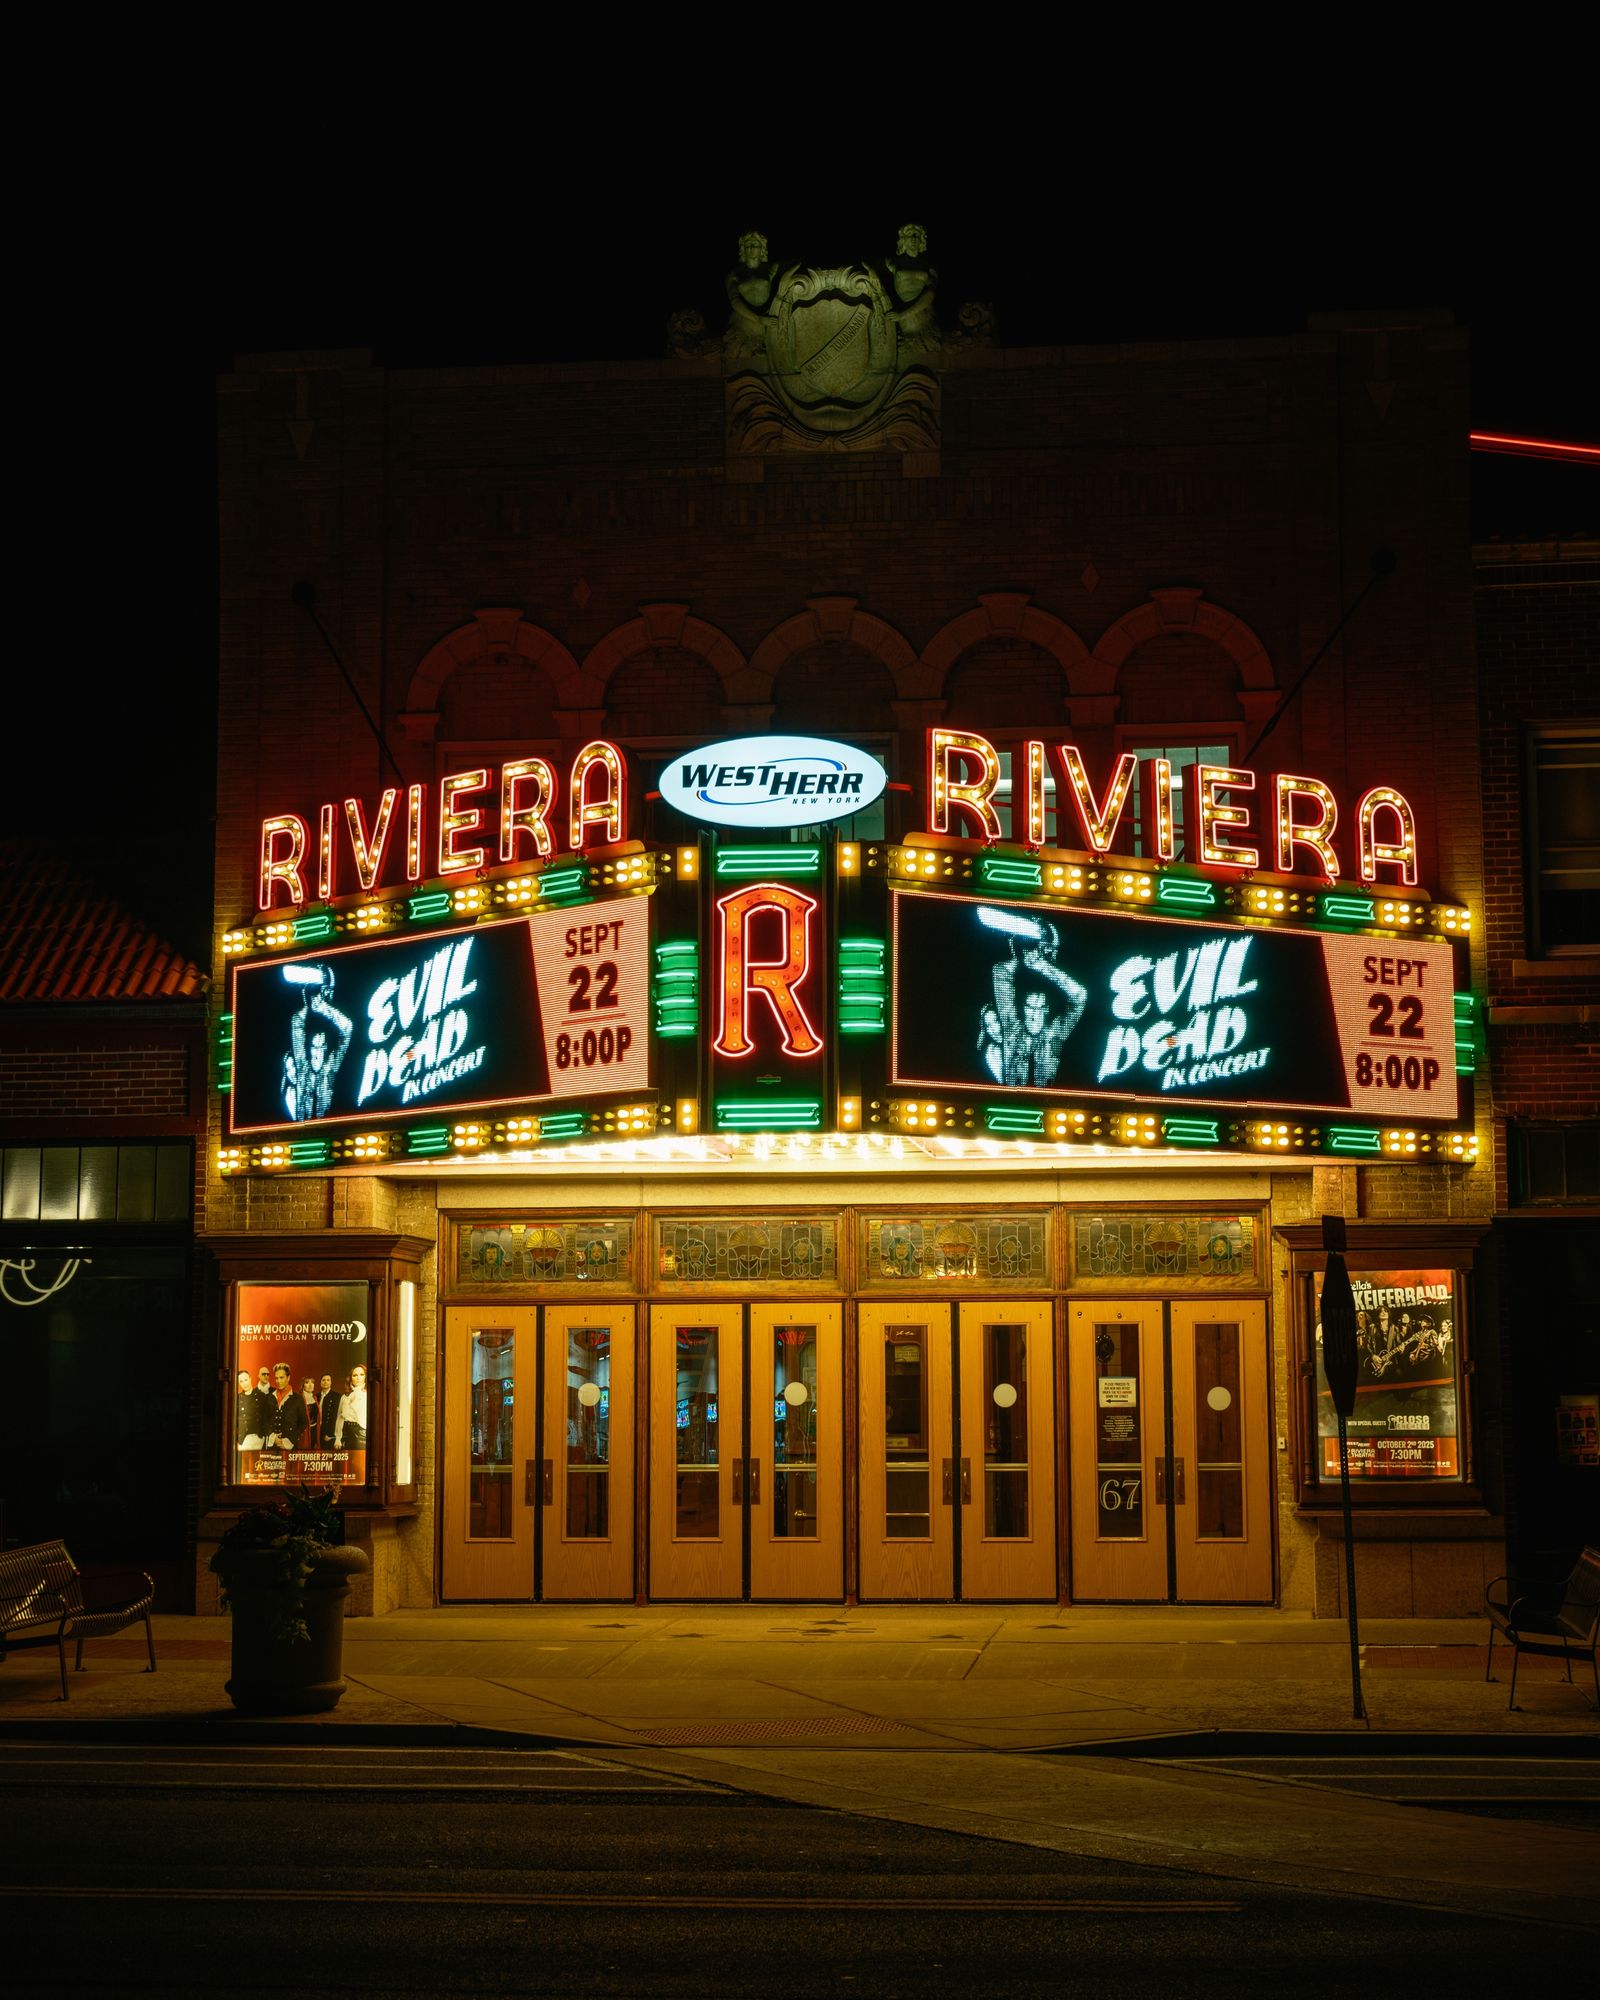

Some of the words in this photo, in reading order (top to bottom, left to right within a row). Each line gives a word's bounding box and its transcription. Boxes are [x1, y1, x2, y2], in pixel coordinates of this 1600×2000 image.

[792, 797, 818, 805] NEW
[828, 796, 861, 804] YORK
[930, 728, 1418, 886] RIVIERA
[259, 740, 625, 910] RIVIERA
[564, 920, 625, 958] SEPT
[367, 935, 478, 1043] EVIL
[567, 961, 619, 1013] 22
[713, 883, 823, 1058] R
[1109, 935, 1258, 1020] EVIL
[1362, 956, 1429, 988] SEPT
[1367, 993, 1425, 1040] 22
[357, 1008, 468, 1107] DEAD
[555, 1025, 632, 1069] 8:00P
[1097, 1005, 1247, 1083] DEAD
[402, 1079, 421, 1104] IN
[421, 1045, 487, 1095] CONCERT
[1161, 1067, 1187, 1091] IN
[1187, 1048, 1271, 1085] CONCERT
[1355, 1051, 1440, 1092] 8:00P
[240, 1324, 262, 1334] NEW
[263, 1324, 293, 1333] MOON
[295, 1324, 309, 1333] ON
[311, 1323, 353, 1333] MONDAY
[288, 1453, 321, 1461] SEPTEMBER
[333, 1452, 349, 1461] 2025
[303, 1461, 333, 1471] 7:30PM
[1377, 1440, 1406, 1449] OCTOBER
[1417, 1440, 1435, 1449] 2025
[1390, 1449, 1422, 1460] 7:30PM
[1100, 1479, 1141, 1511] 67
